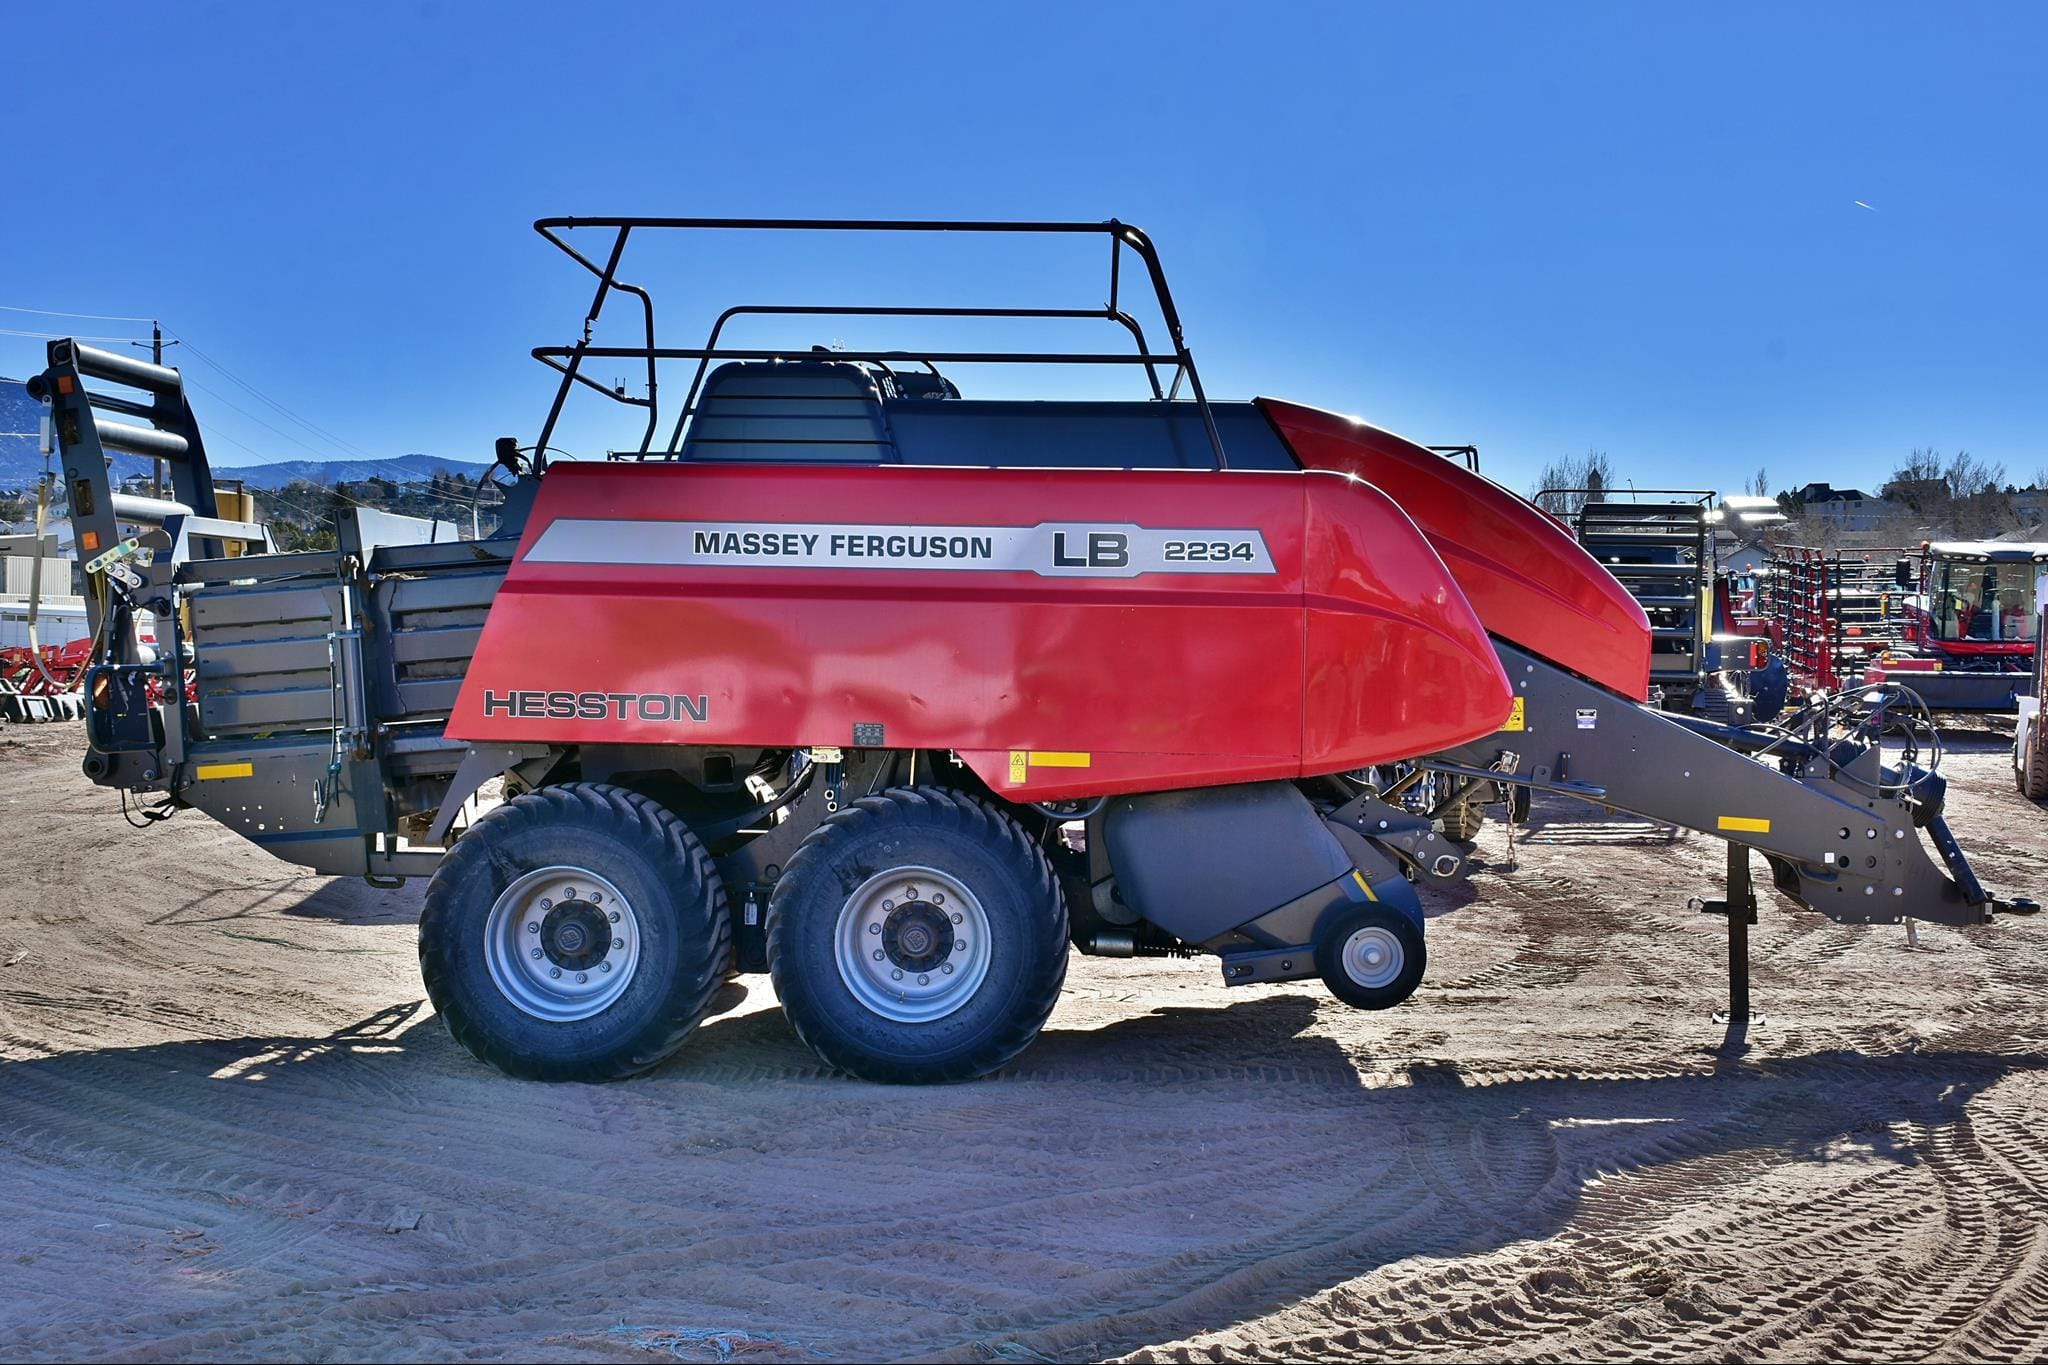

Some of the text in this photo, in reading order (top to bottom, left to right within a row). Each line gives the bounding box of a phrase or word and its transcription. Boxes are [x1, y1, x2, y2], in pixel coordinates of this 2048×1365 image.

[694, 532, 1254, 568] MASSEY FERGUSON LB 2234
[484, 690, 709, 722] HESSTON
